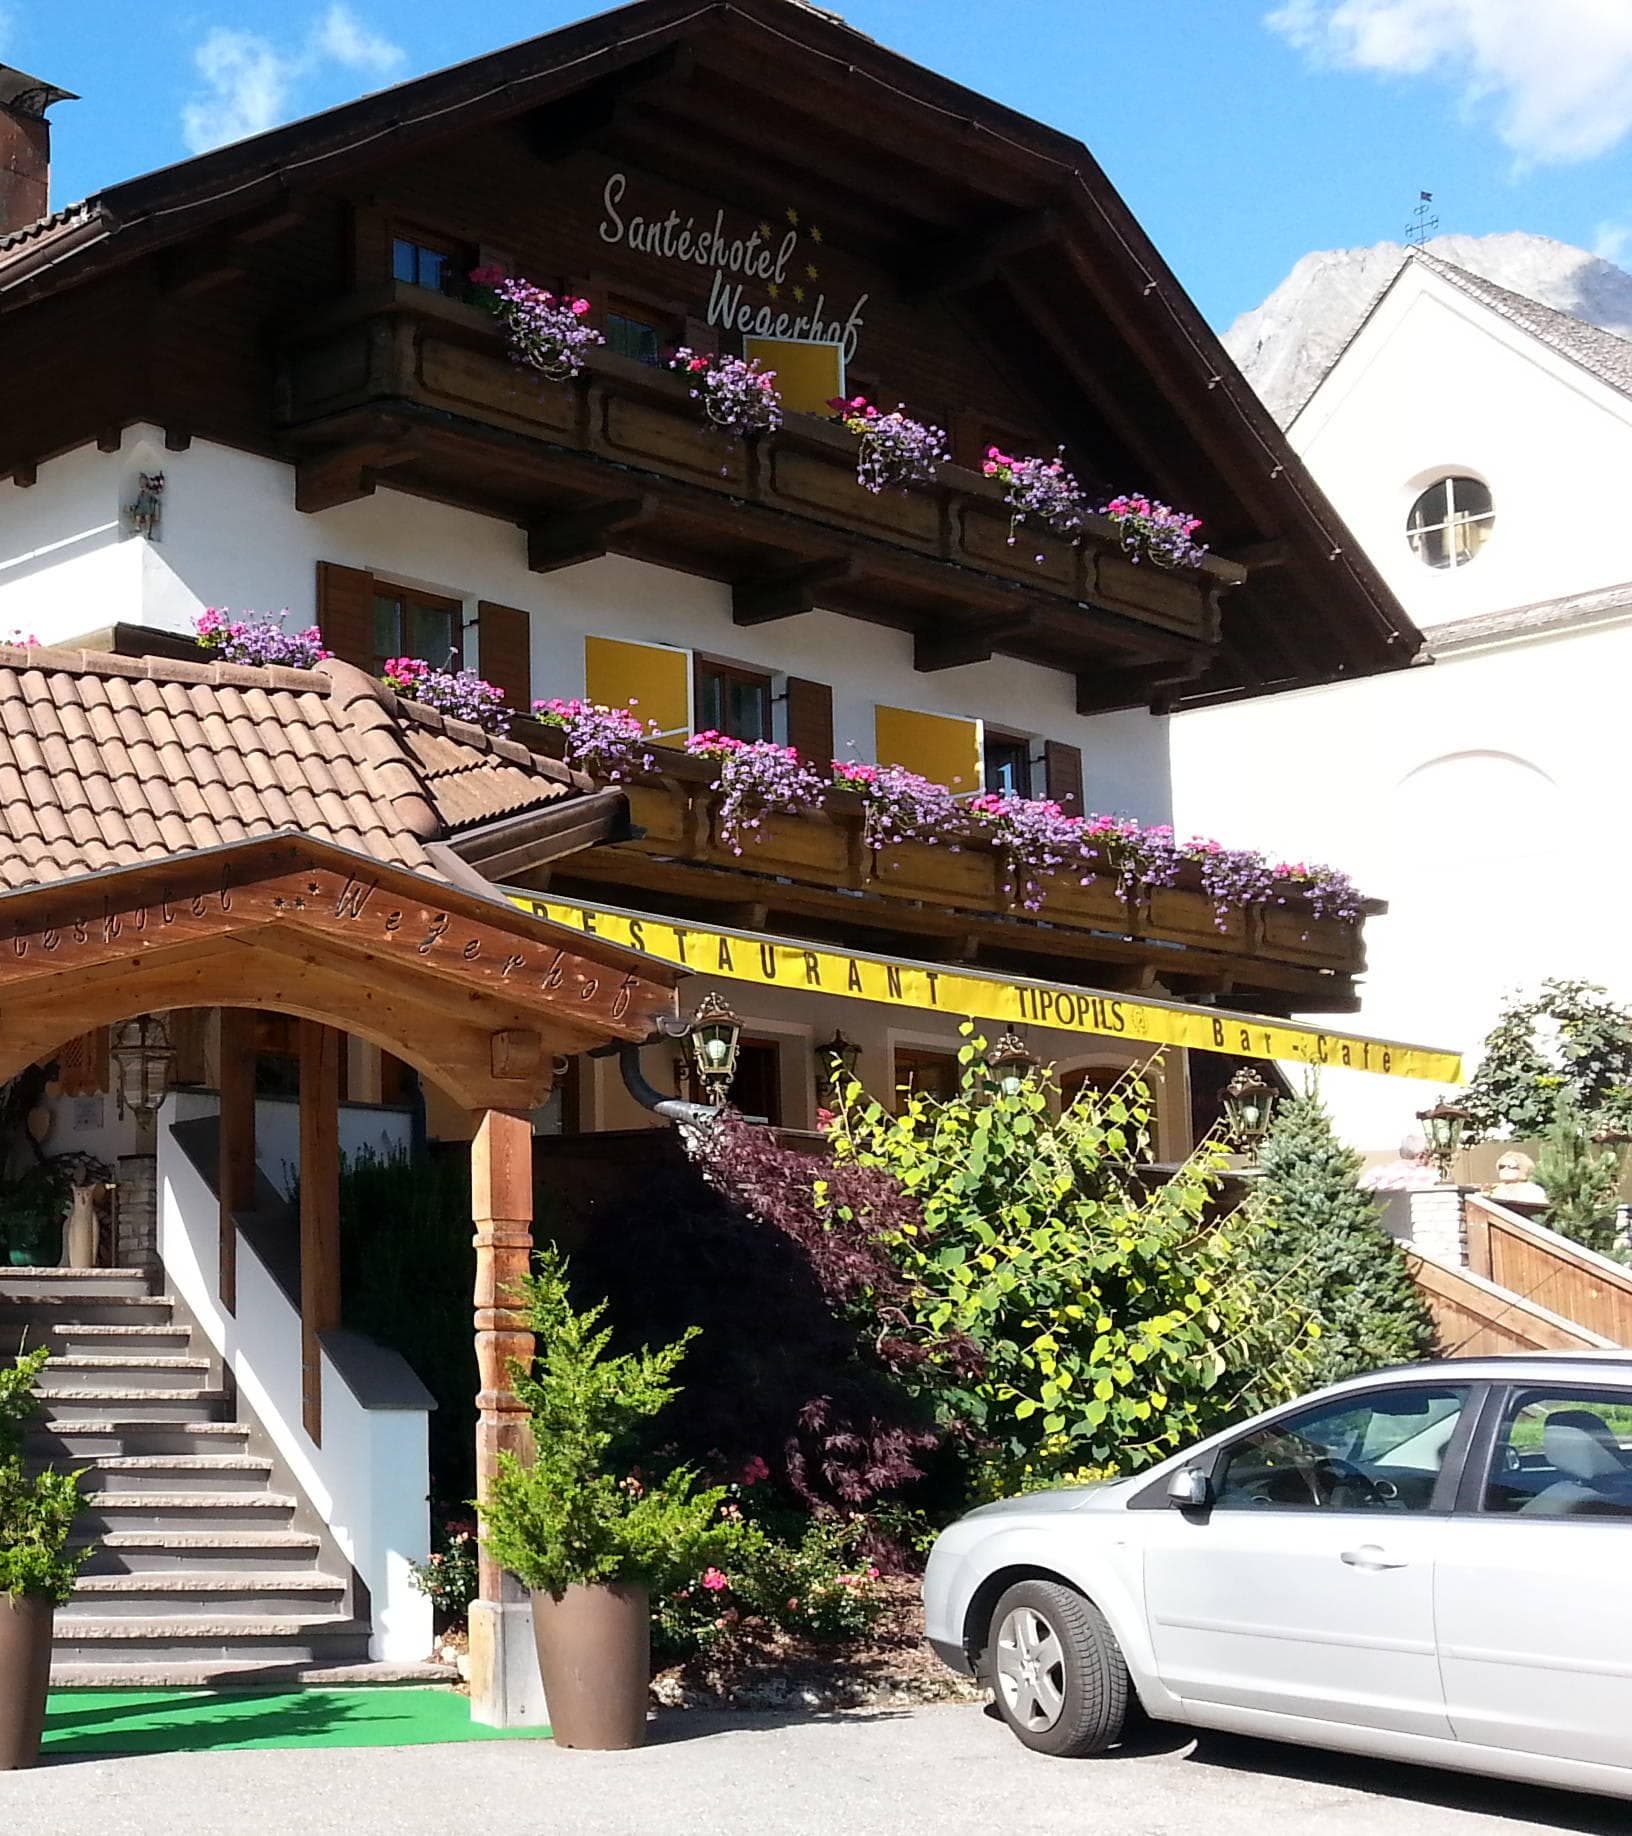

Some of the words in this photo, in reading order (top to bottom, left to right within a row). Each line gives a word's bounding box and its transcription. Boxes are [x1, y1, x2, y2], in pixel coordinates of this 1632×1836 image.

[599, 173, 797, 284] Santéshotel
[335, 872, 640, 1020] Wegerhof
[1014, 985, 1125, 1032] TIPOPILS
